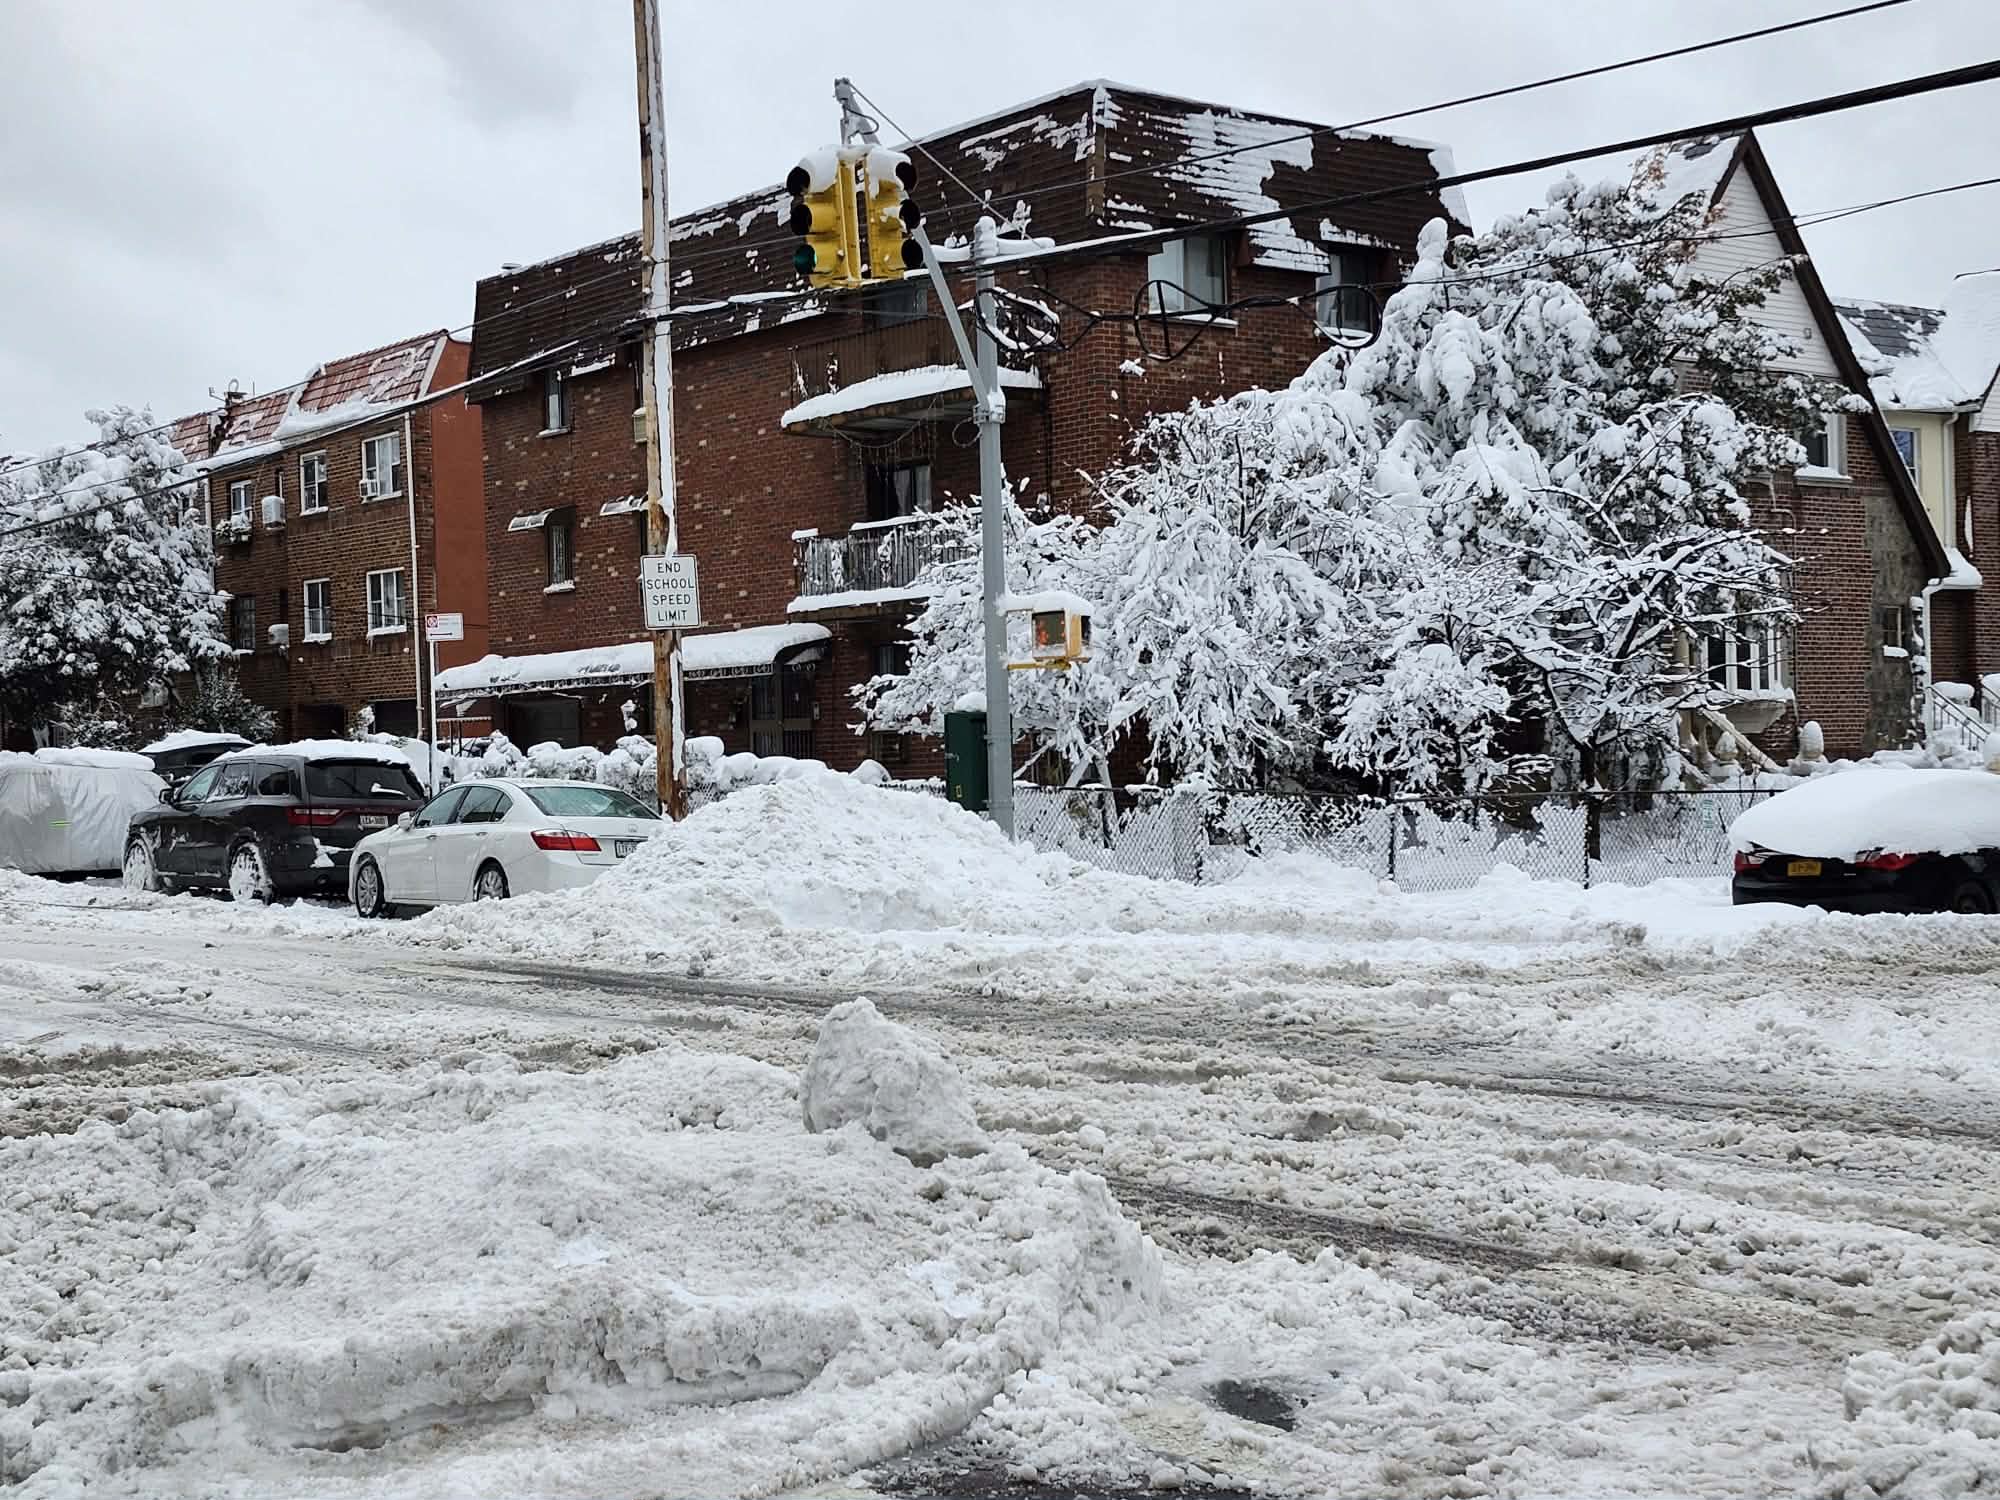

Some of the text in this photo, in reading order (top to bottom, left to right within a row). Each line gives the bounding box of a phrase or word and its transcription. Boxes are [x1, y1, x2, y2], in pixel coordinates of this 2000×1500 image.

[657, 562, 681, 573] END
[646, 578, 695, 590] SCHOOL
[652, 594, 691, 606] SPEED
[657, 610, 687, 622] LIMIT
